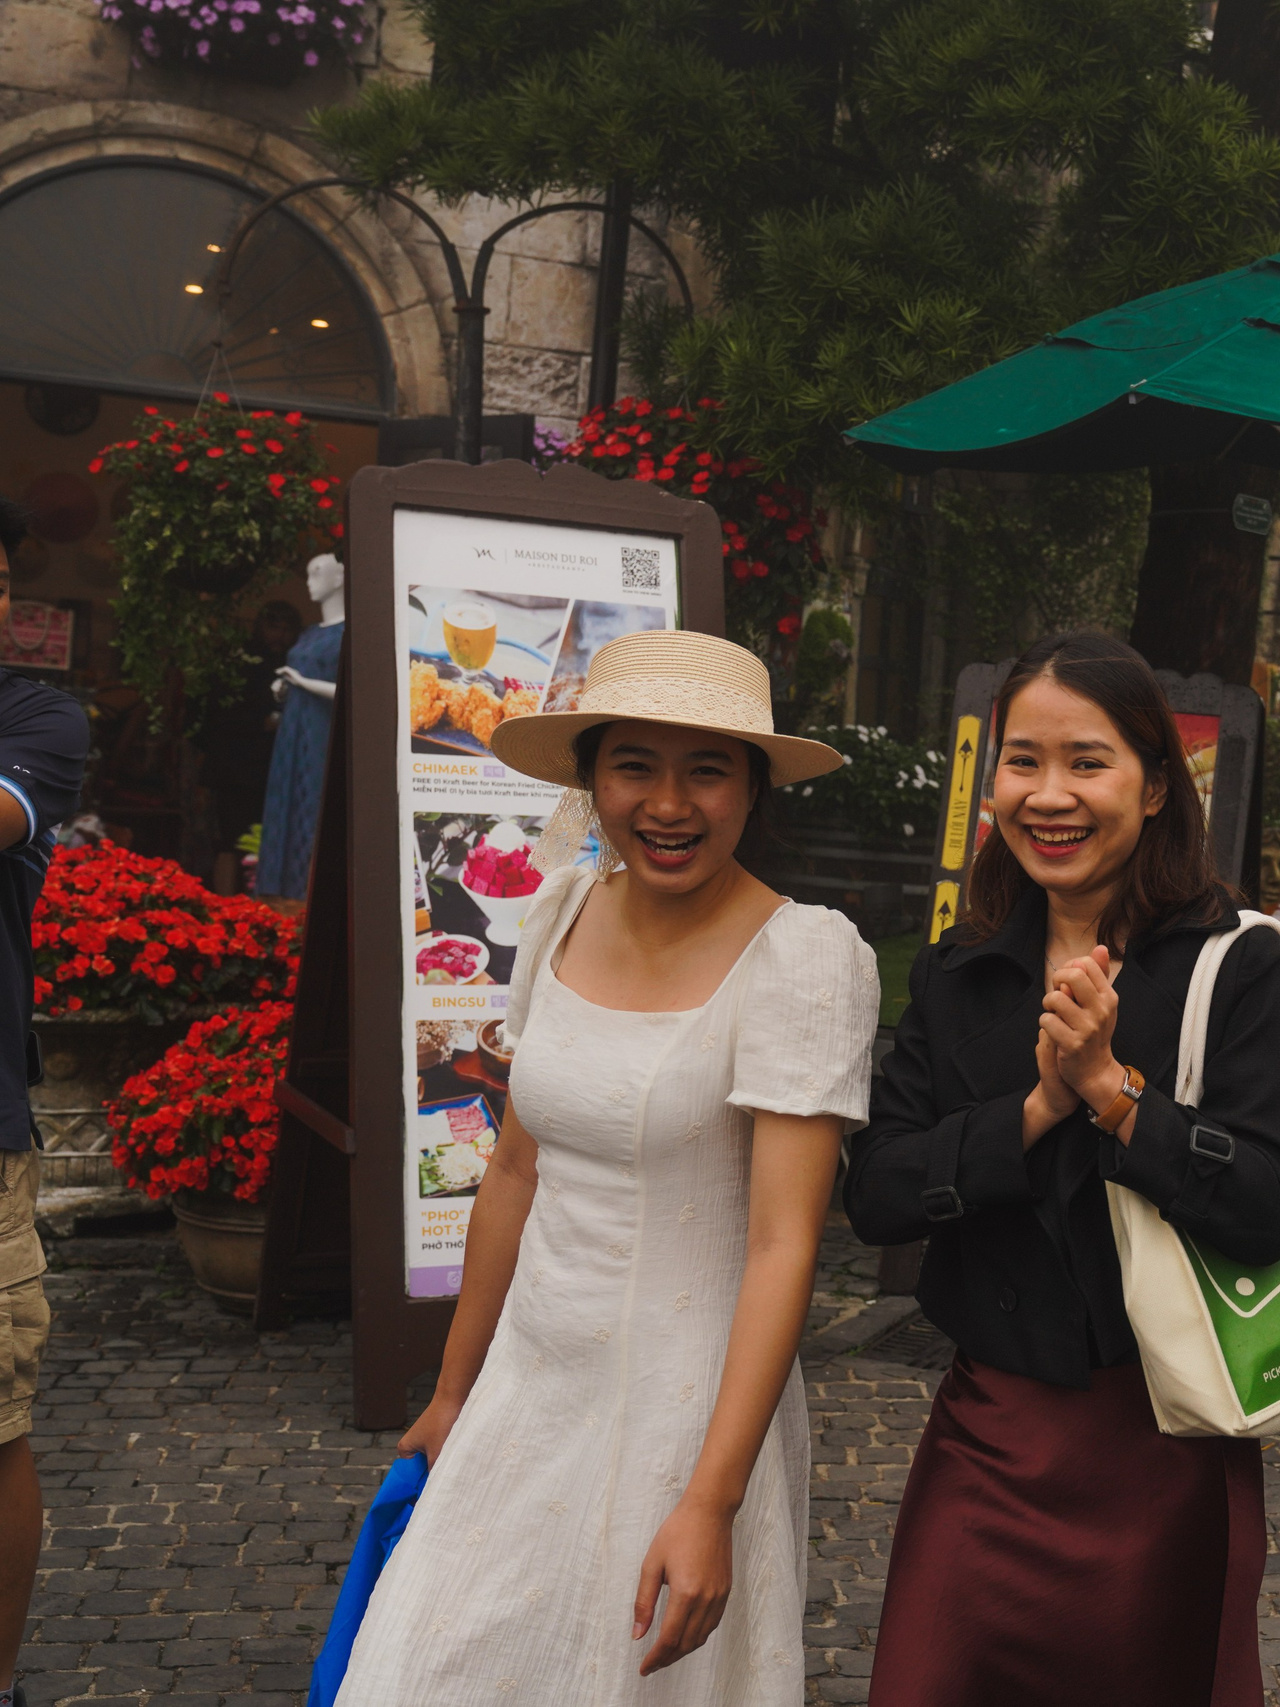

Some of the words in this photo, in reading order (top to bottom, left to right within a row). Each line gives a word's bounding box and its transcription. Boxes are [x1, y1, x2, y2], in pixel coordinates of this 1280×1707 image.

[514, 549, 558, 564] MAISON
[561, 554, 577, 565] DU
[579, 555, 598, 567] ROI
[412, 763, 478, 776] CHIMAEK
[412, 777, 431, 785] FREE
[443, 779, 460, 787] Kraft
[480, 780, 490, 788] for
[491, 781, 517, 789] Korean
[518, 782, 536, 790] Fried
[459, 788, 466, 797] ly
[466, 788, 478, 796] bia
[513, 790, 530, 798] Beer
[530, 791, 543, 799] khi
[432, 996, 486, 1008] BINGSU
[421, 1210, 465, 1222] "PHO"
[421, 1224, 452, 1237] HOT
